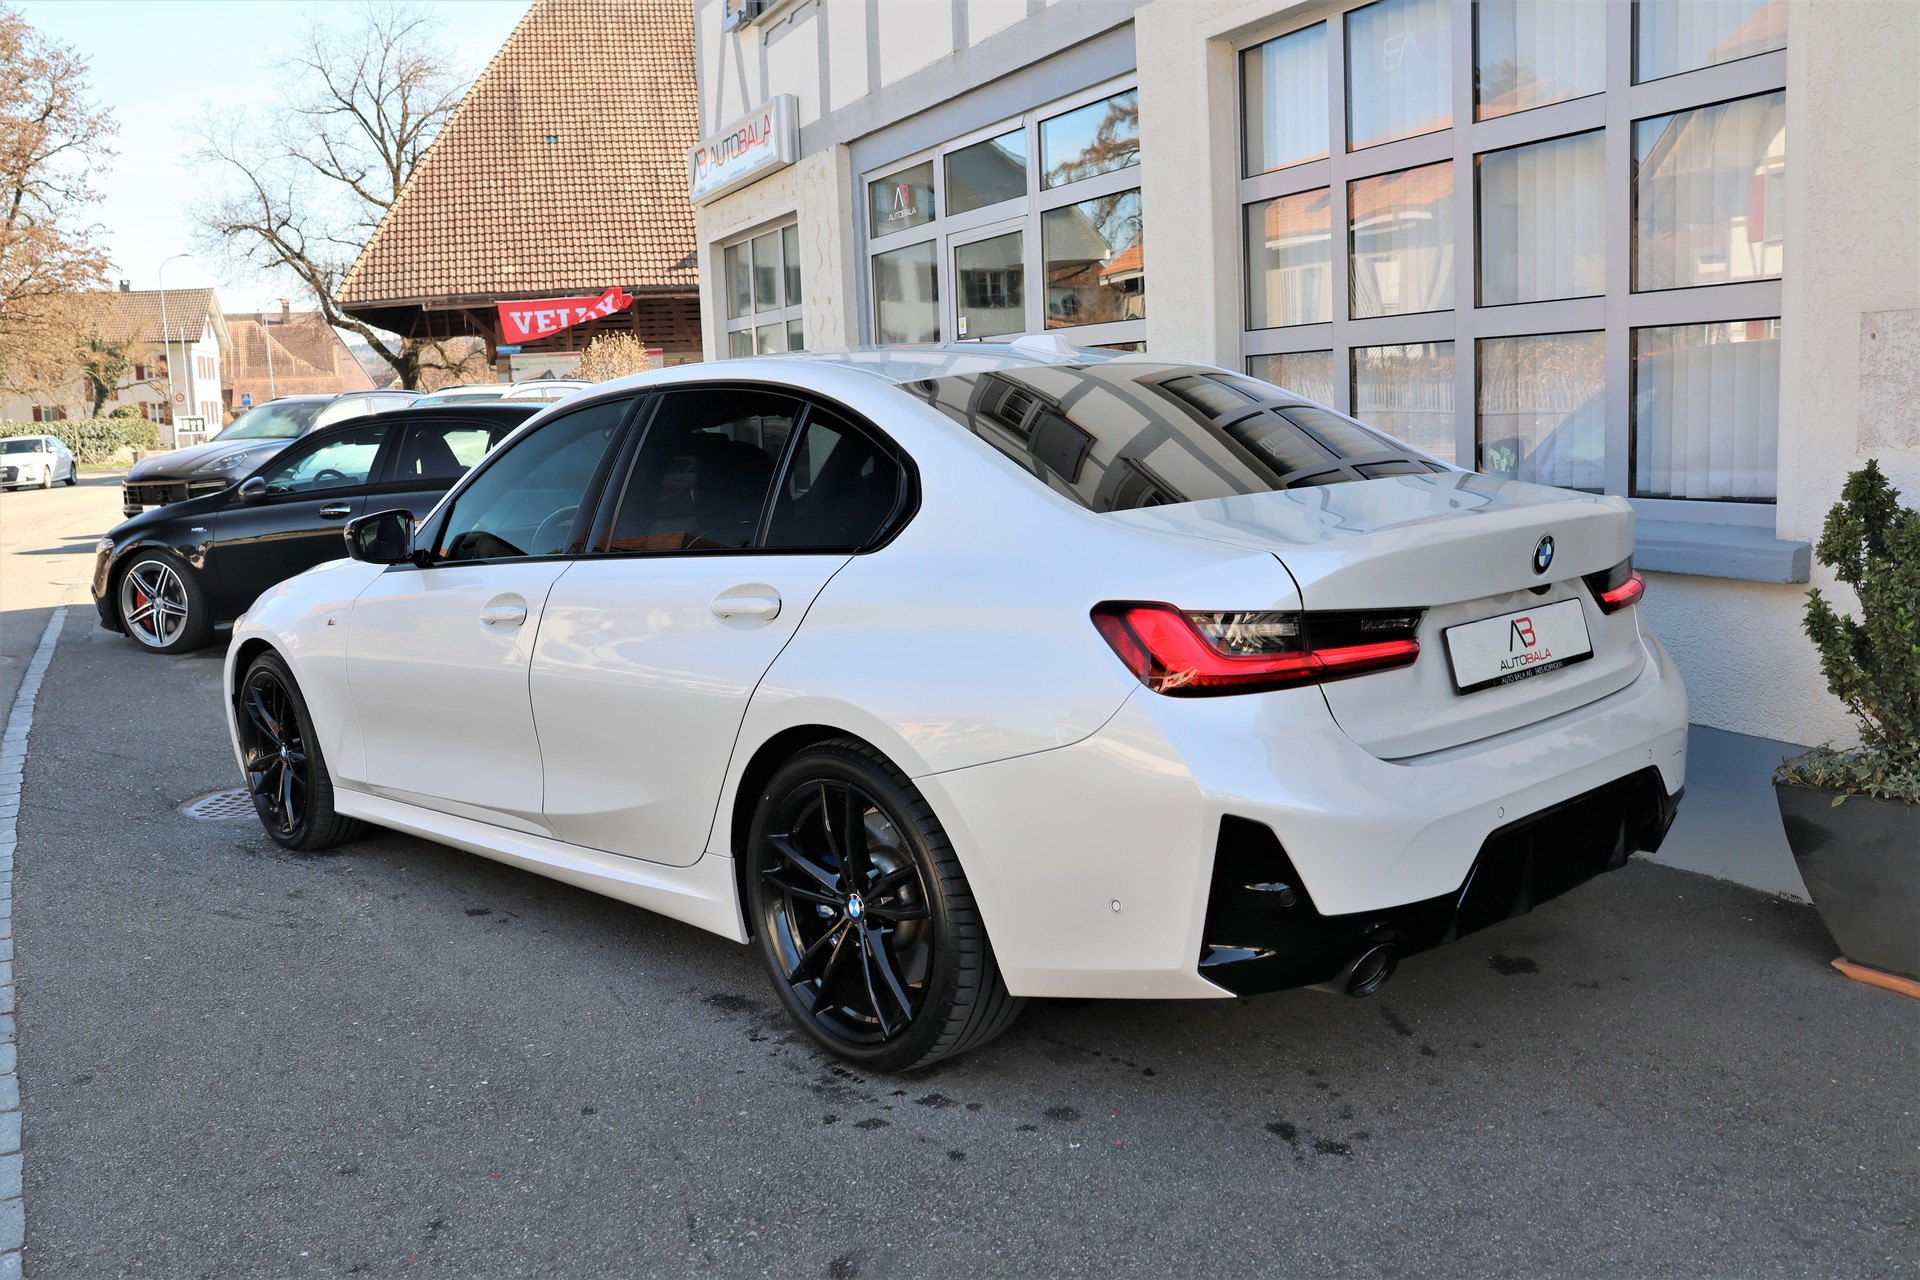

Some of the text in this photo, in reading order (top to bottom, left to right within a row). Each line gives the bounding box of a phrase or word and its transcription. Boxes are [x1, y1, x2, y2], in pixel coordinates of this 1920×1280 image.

[709, 113, 773, 172] AUTOBALA
[888, 206, 917, 221] AUTOBALA
[1500, 648, 1552, 671] AUTOBALA
[1501, 674, 1515, 684] AUTO
[1514, 671, 1526, 681] BALA
